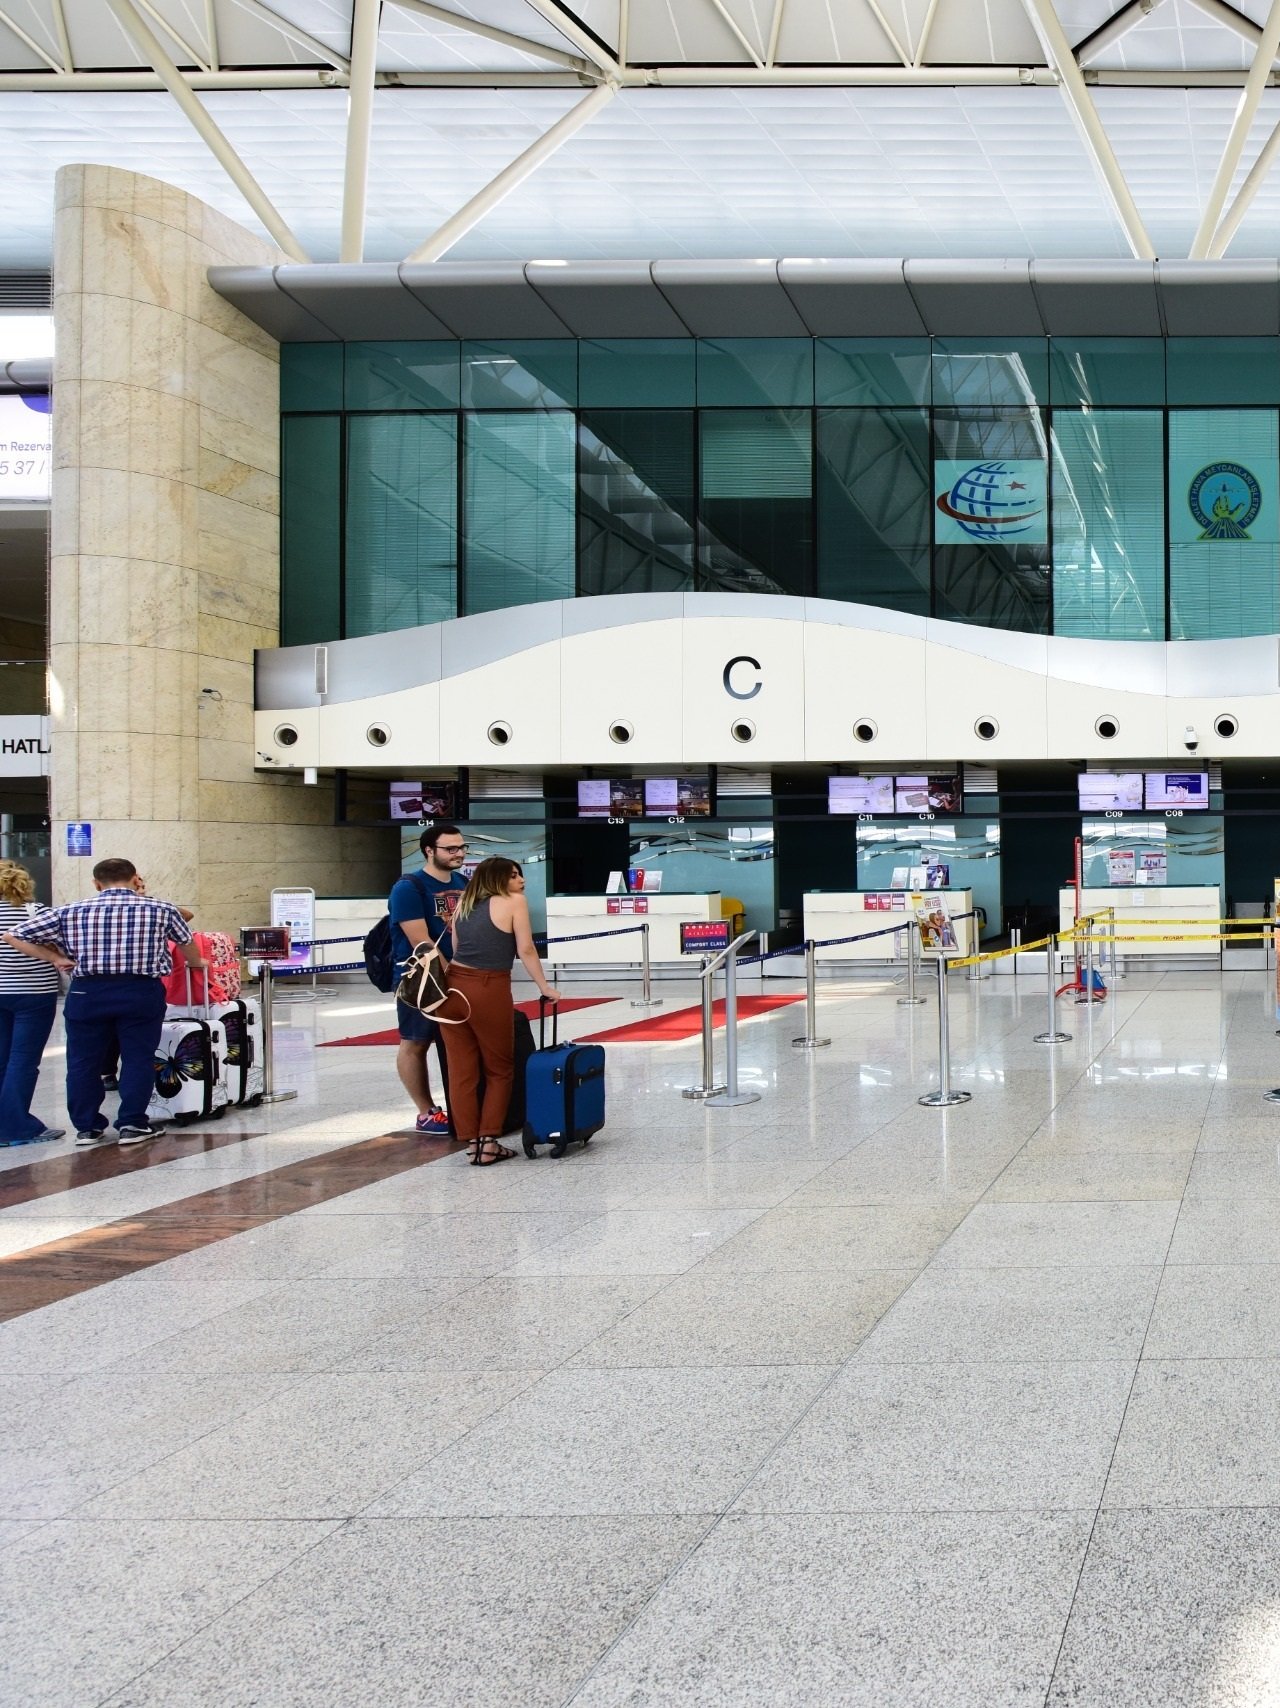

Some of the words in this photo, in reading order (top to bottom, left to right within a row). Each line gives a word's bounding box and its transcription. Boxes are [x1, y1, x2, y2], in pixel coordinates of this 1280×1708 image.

[13, 460, 35, 475] 37
[723, 656, 762, 700] C
[3, 739, 51, 753] HATL
